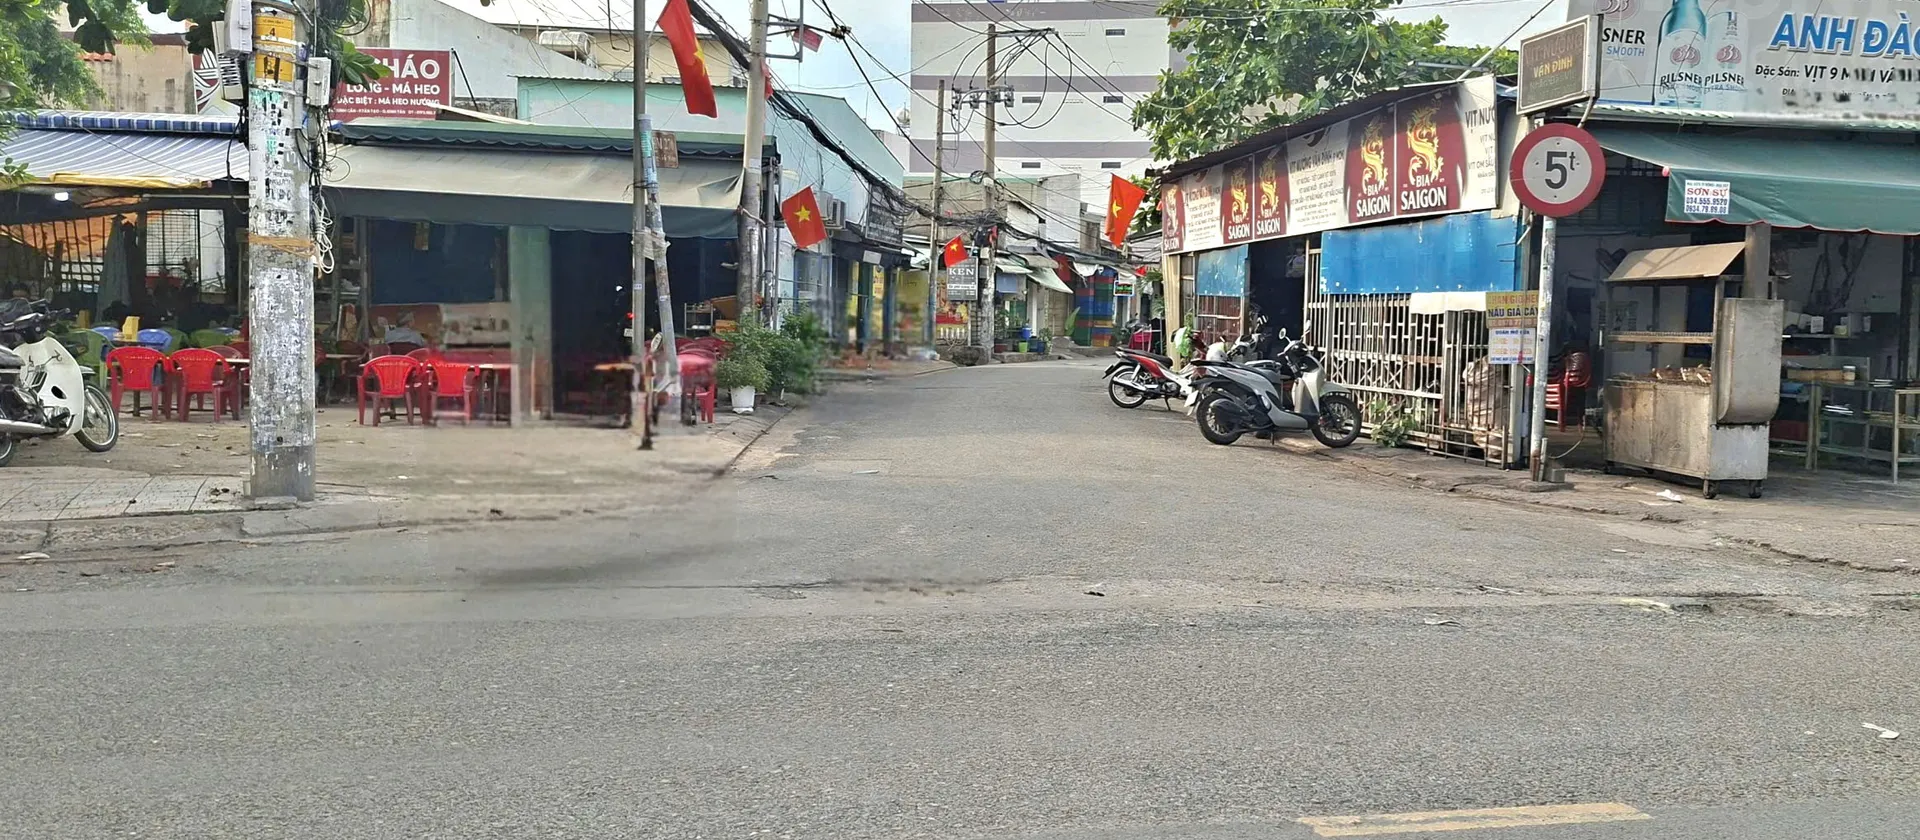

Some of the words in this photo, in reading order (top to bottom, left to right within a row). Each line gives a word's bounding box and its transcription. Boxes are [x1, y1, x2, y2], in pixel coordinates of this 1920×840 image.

[269, 27, 276, 37] 4
[1769, 12, 1856, 54] ANH
[1862, 11, 1920, 58] ĐÀ
[1606, 46, 1645, 57] SMOOTH
[374, 54, 440, 79] HÁO
[1755, 65, 1775, 78] Đặc
[1804, 65, 1826, 82] VỊT
[1830, 67, 1838, 80] 9
[392, 81, 411, 95] MÁ
[414, 84, 440, 95] HEO
[356, 95, 373, 106] BIỆT
[378, 96, 392, 105] MÁ
[1465, 110, 1478, 132] VỊT
[1416, 174, 1430, 187] BIA
[1367, 183, 1379, 197] BIA
[1687, 187, 1709, 196] SƠN
[1401, 186, 1447, 211] SAIGON
[1356, 194, 1390, 218] SAIGON
[1228, 222, 1251, 240] SAIGON
[1256, 217, 1281, 235] SAIGON
[1163, 237, 1180, 251] SAIGON
[949, 267, 975, 276] KEN
